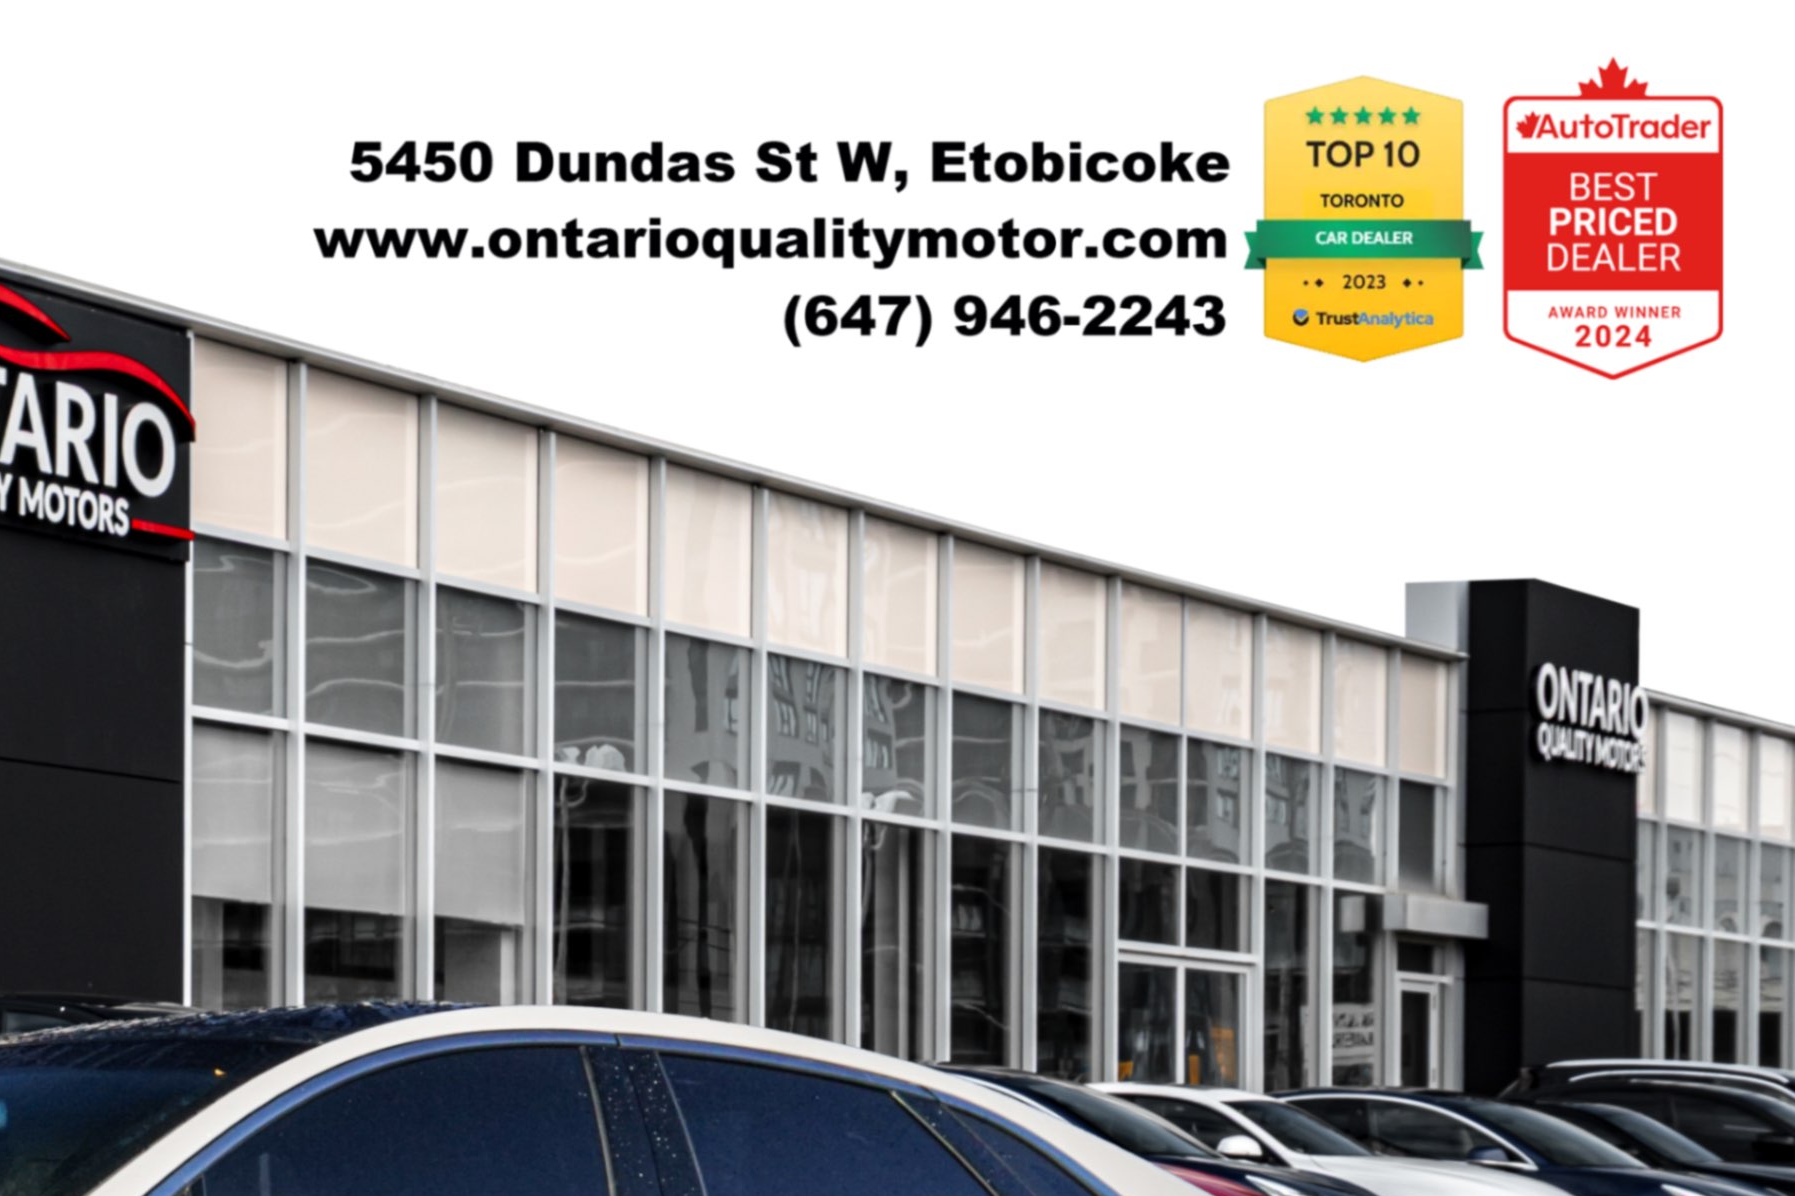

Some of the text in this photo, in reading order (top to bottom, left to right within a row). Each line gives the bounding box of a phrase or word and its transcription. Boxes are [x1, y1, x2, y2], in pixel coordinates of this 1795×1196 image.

[19, 476, 130, 537] MOTORS
[1537, 662, 1650, 740] ONTARIO
[1537, 722, 1647, 774] QUALITY MOTORS
